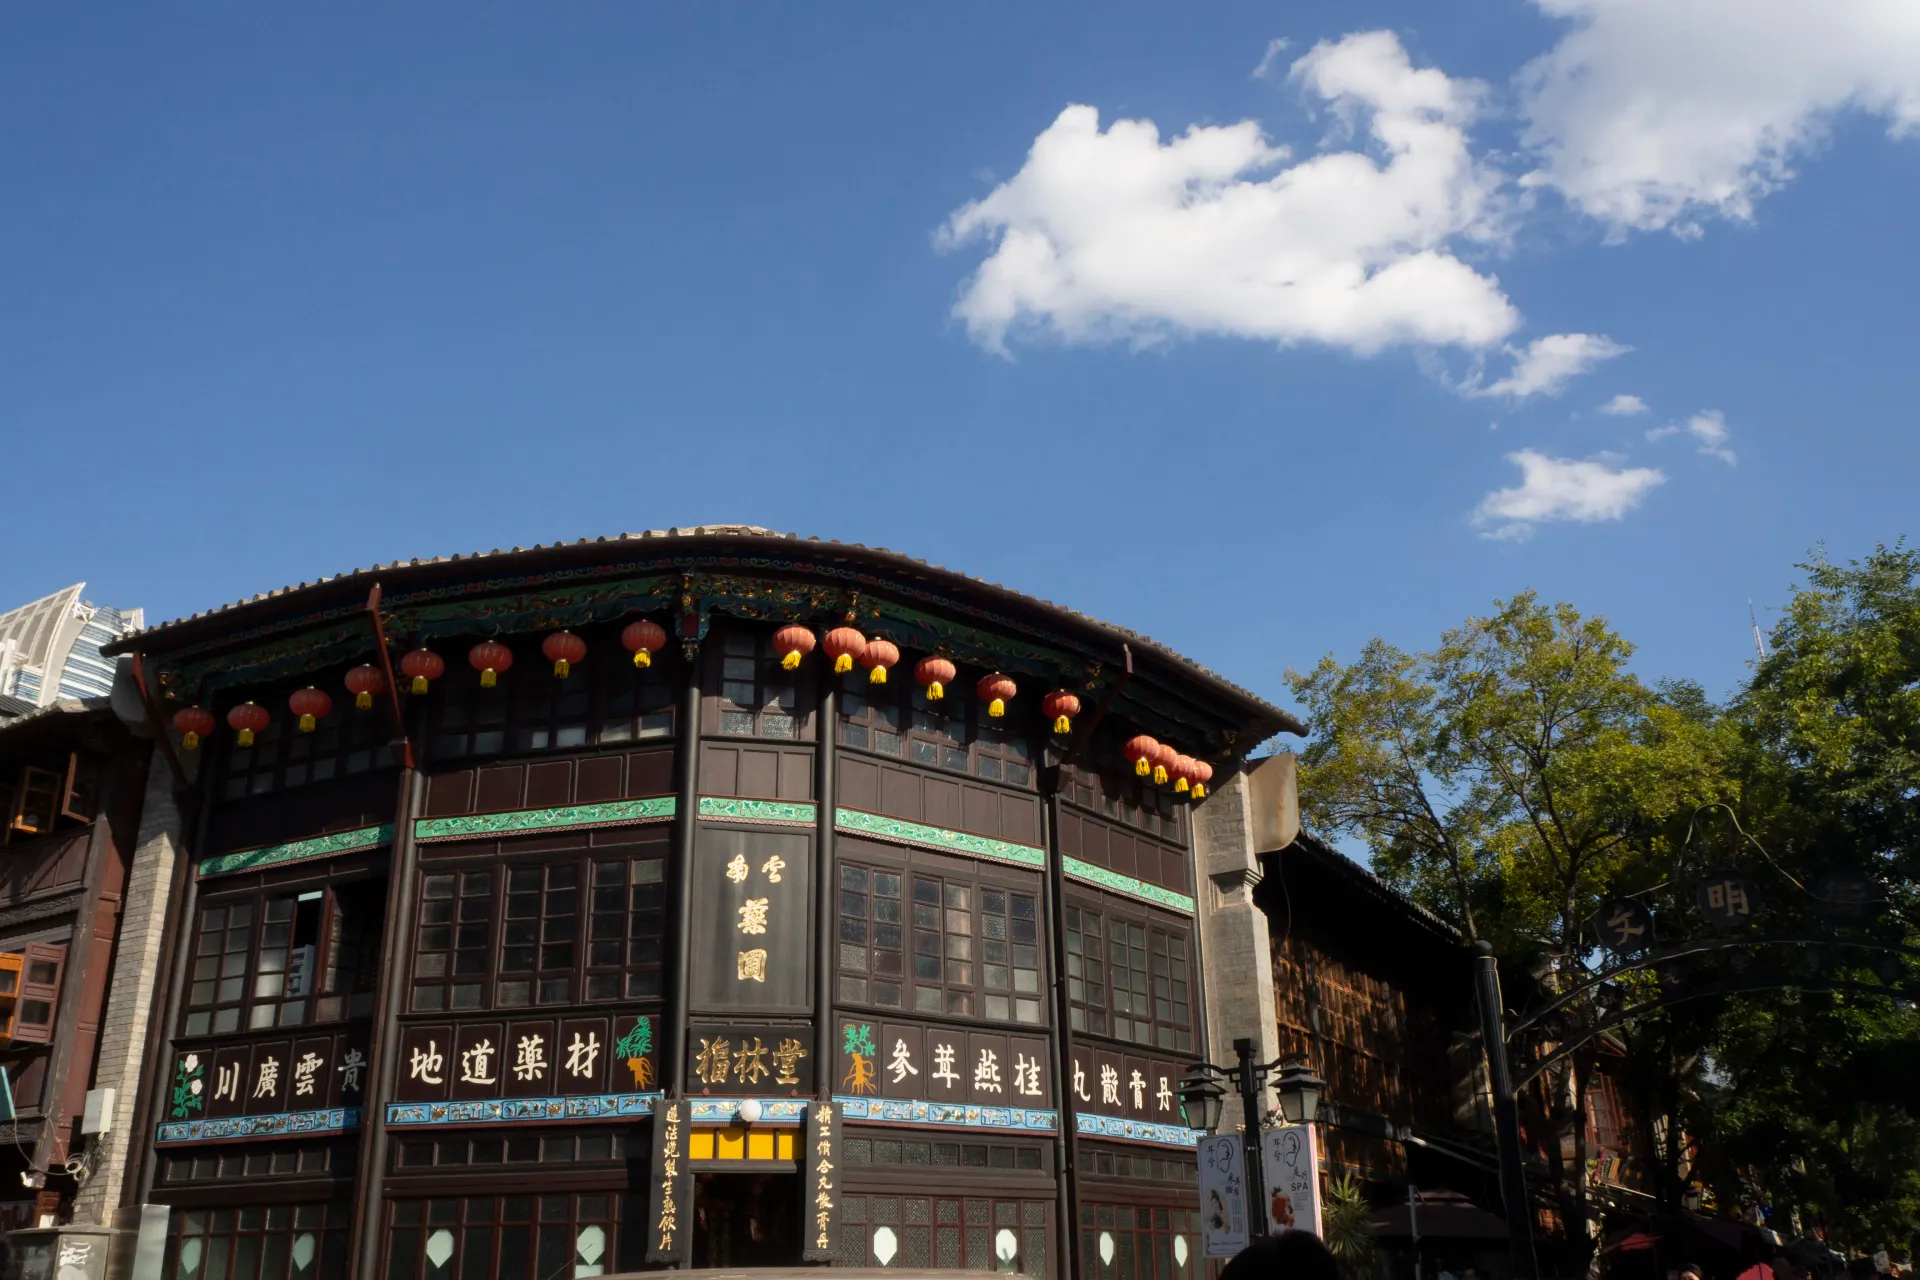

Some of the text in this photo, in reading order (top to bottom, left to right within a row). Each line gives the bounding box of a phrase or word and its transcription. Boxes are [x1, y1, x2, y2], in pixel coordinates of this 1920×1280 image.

[695, 1036, 809, 1085] 福林堂
[1073, 1059, 1173, 1112] 丸散膏丹
[1290, 1181, 1309, 1192] SPA
